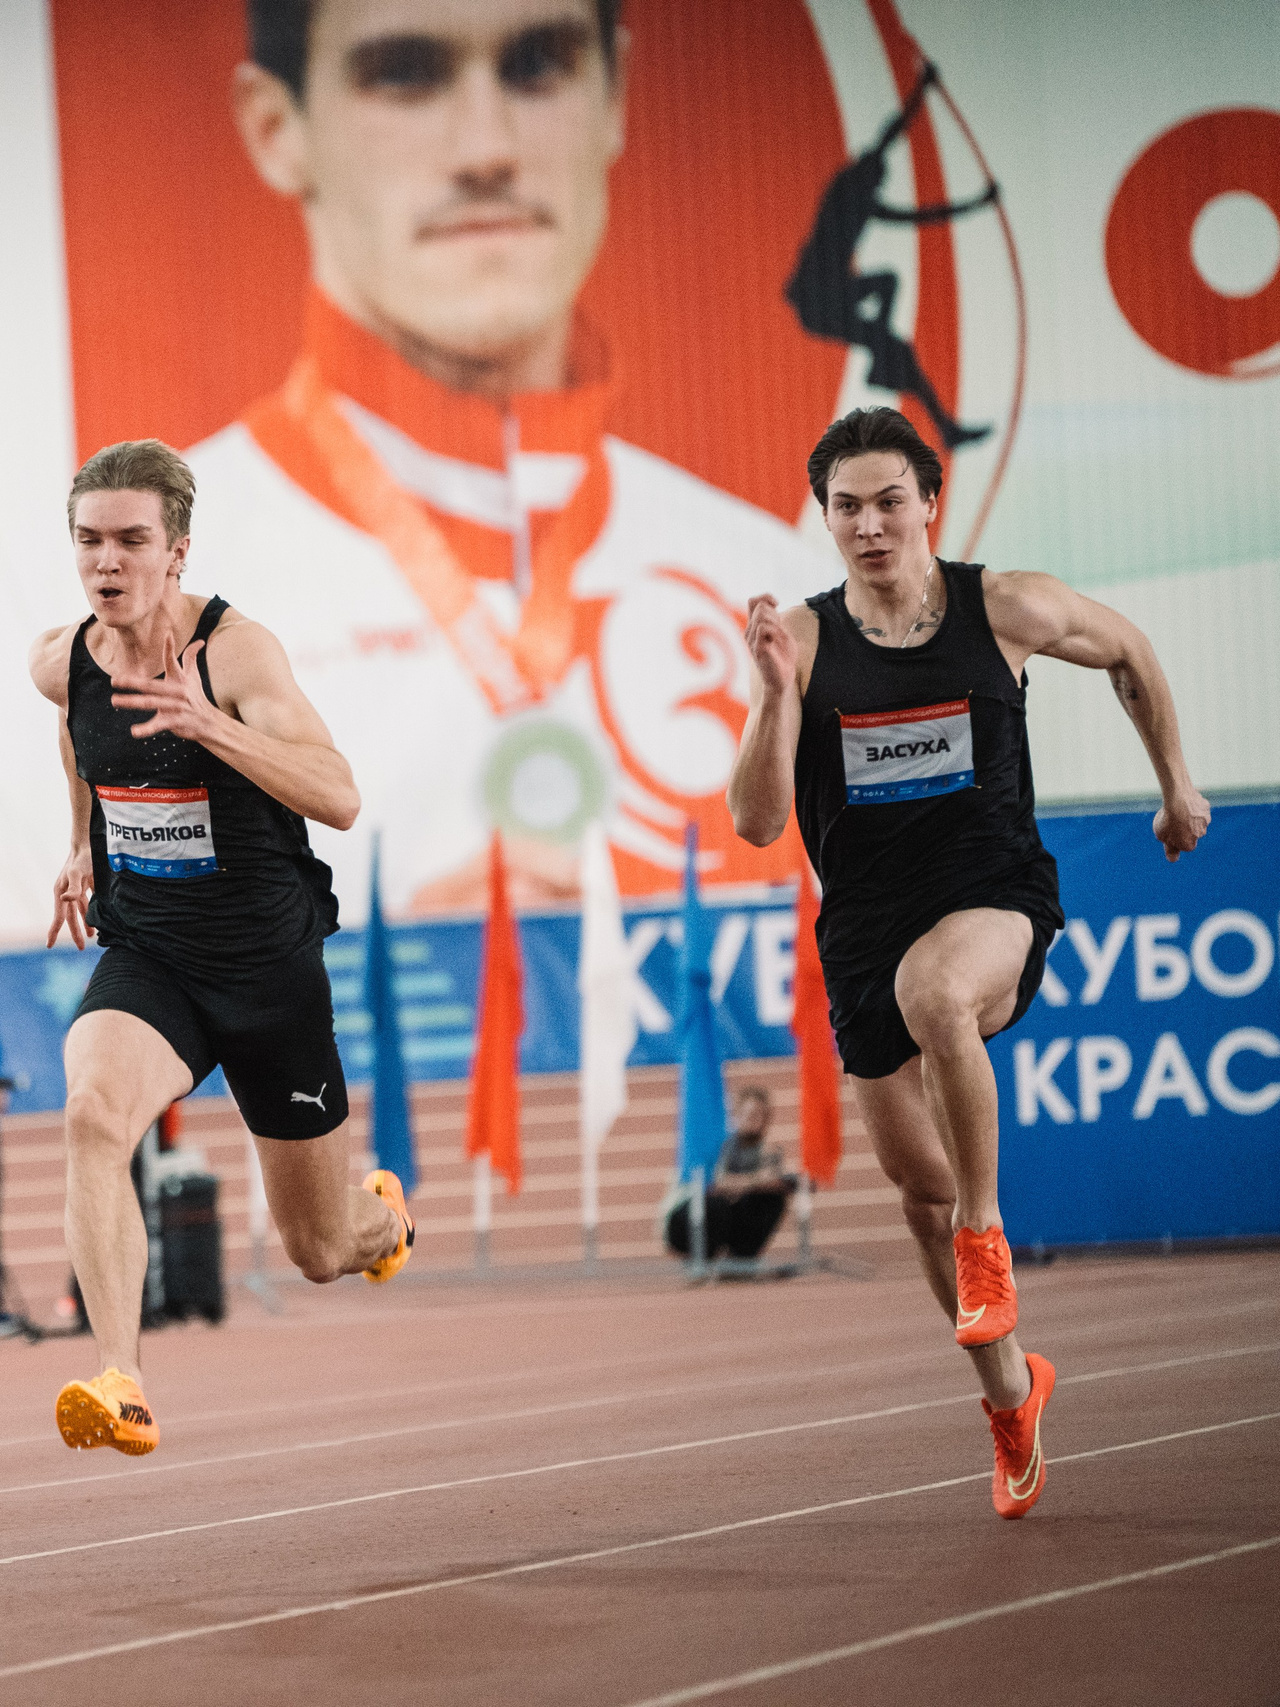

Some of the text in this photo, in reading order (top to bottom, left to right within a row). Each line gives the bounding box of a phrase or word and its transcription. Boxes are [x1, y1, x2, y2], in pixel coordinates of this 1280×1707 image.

[866, 738, 951, 762] ЗАСУХА
[108, 821, 207, 842] ТРЕТЬЯКОВ
[1038, 908, 1280, 1006] УБО
[1013, 1025, 1280, 1127] КРАС
[119, 1401, 152, 1426] NITRO
